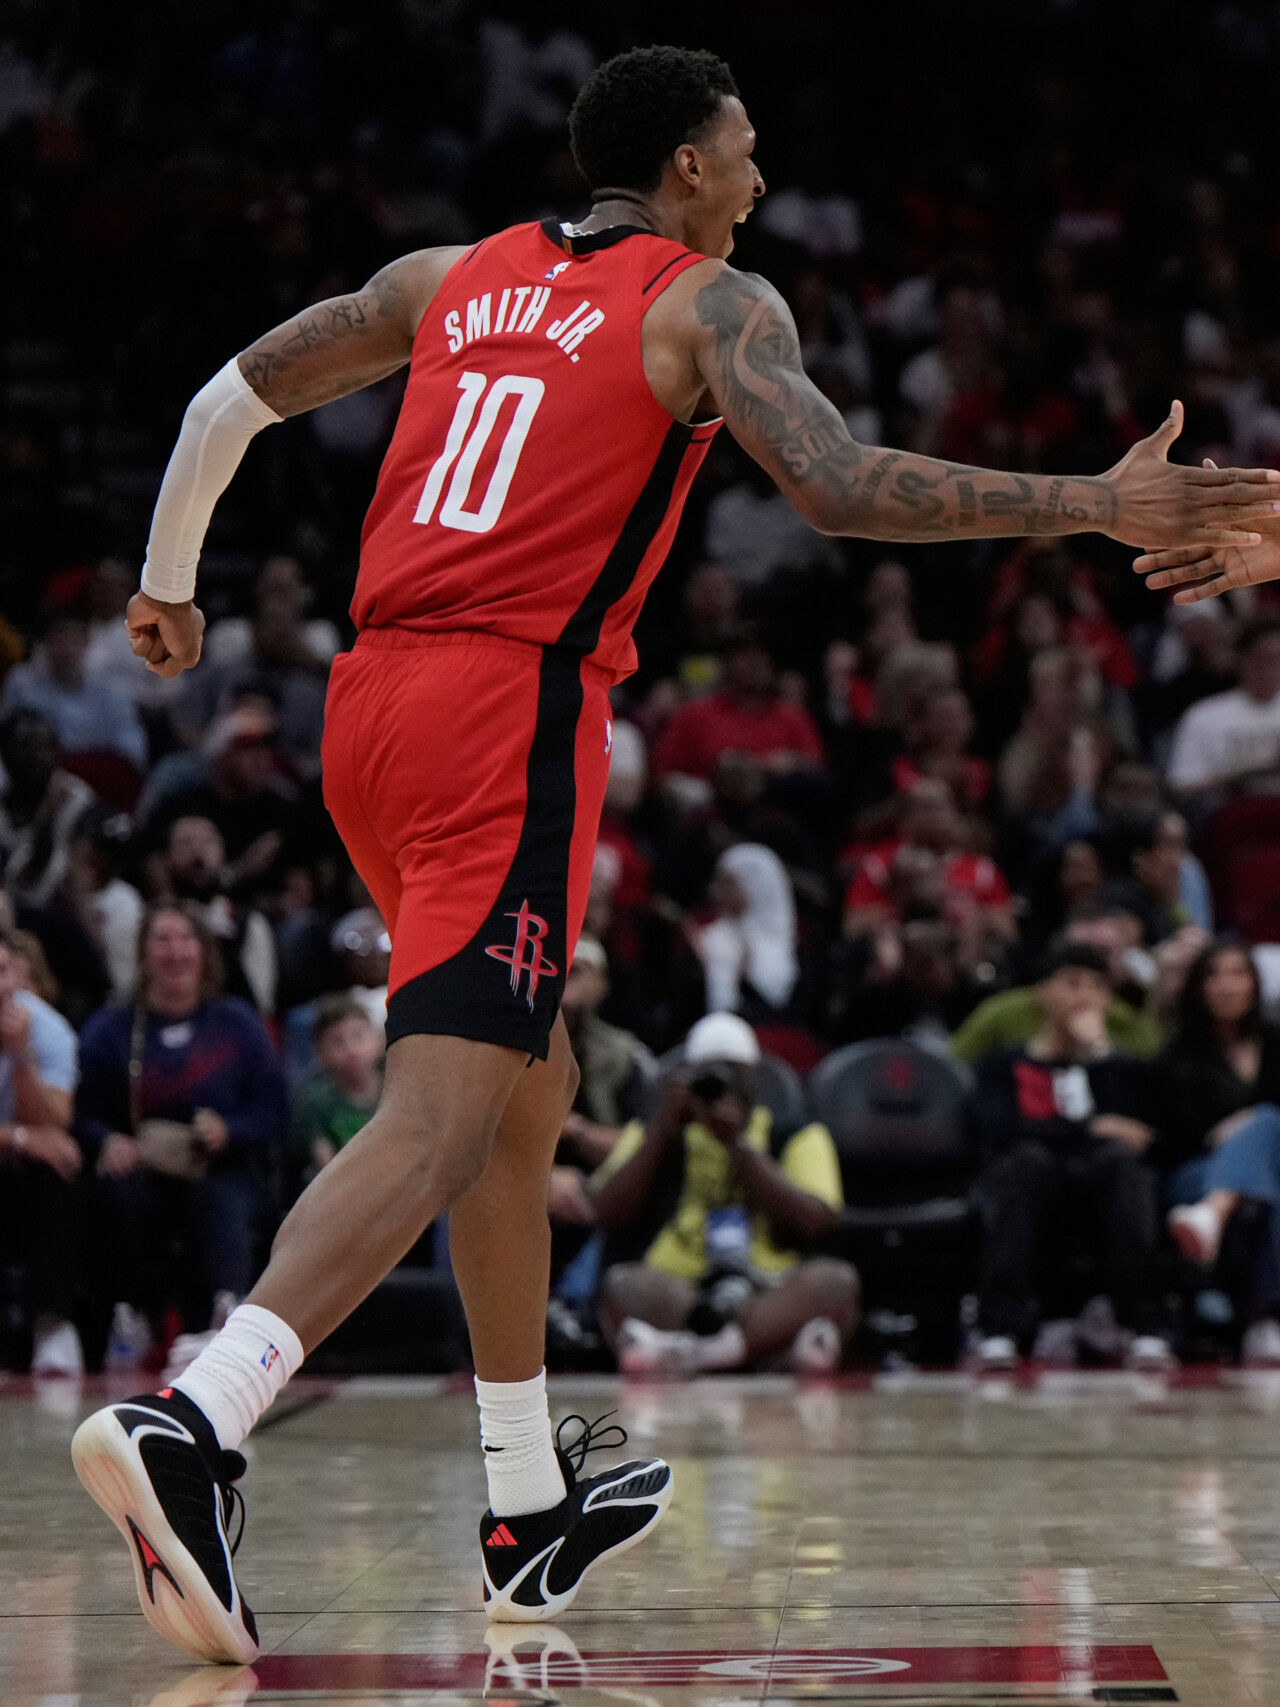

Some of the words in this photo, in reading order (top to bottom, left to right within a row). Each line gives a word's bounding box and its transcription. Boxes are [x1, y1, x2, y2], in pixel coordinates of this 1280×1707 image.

[444, 286, 551, 353] SMITH
[546, 300, 605, 363] JR.
[412, 371, 545, 533] 10
